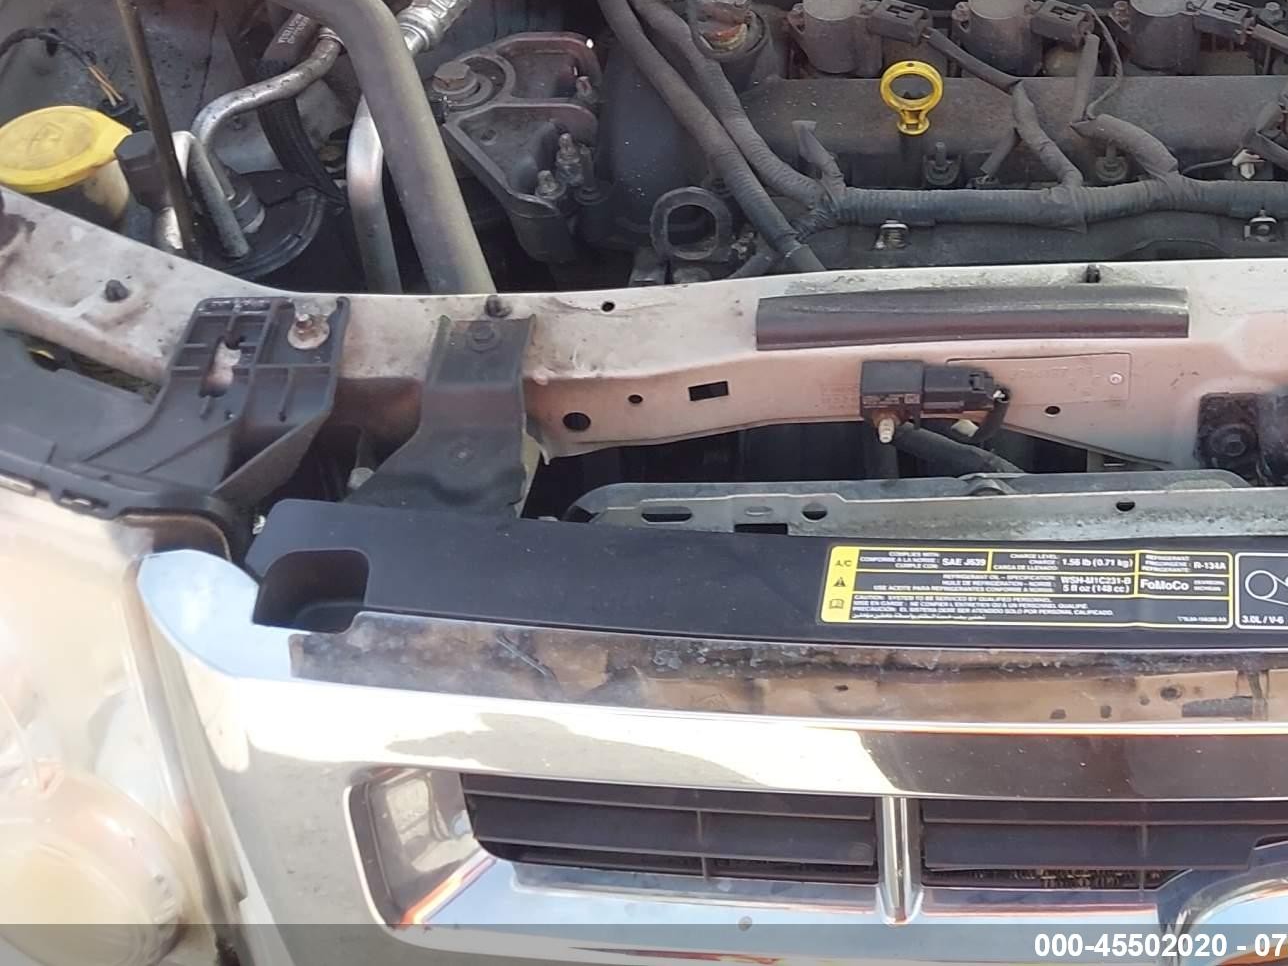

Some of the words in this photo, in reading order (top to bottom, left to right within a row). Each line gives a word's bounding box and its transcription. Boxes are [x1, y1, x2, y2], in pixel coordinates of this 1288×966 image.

[942, 558, 962, 566] SAE
[1081, 558, 1091, 567] lb
[1092, 558, 1116, 568] (0.71
[1116, 559, 1133, 568] kg)
[1193, 561, 1227, 570] R-134A
[1062, 584, 1069, 592] 5
[1070, 584, 1079, 592] fl
[1091, 584, 1113, 593] (148
[1113, 585, 1130, 594] cc)
[1140, 578, 1190, 591] FoMoCo
[1241, 615, 1262, 624] 3.0L
[1268, 616, 1285, 625] V-6
